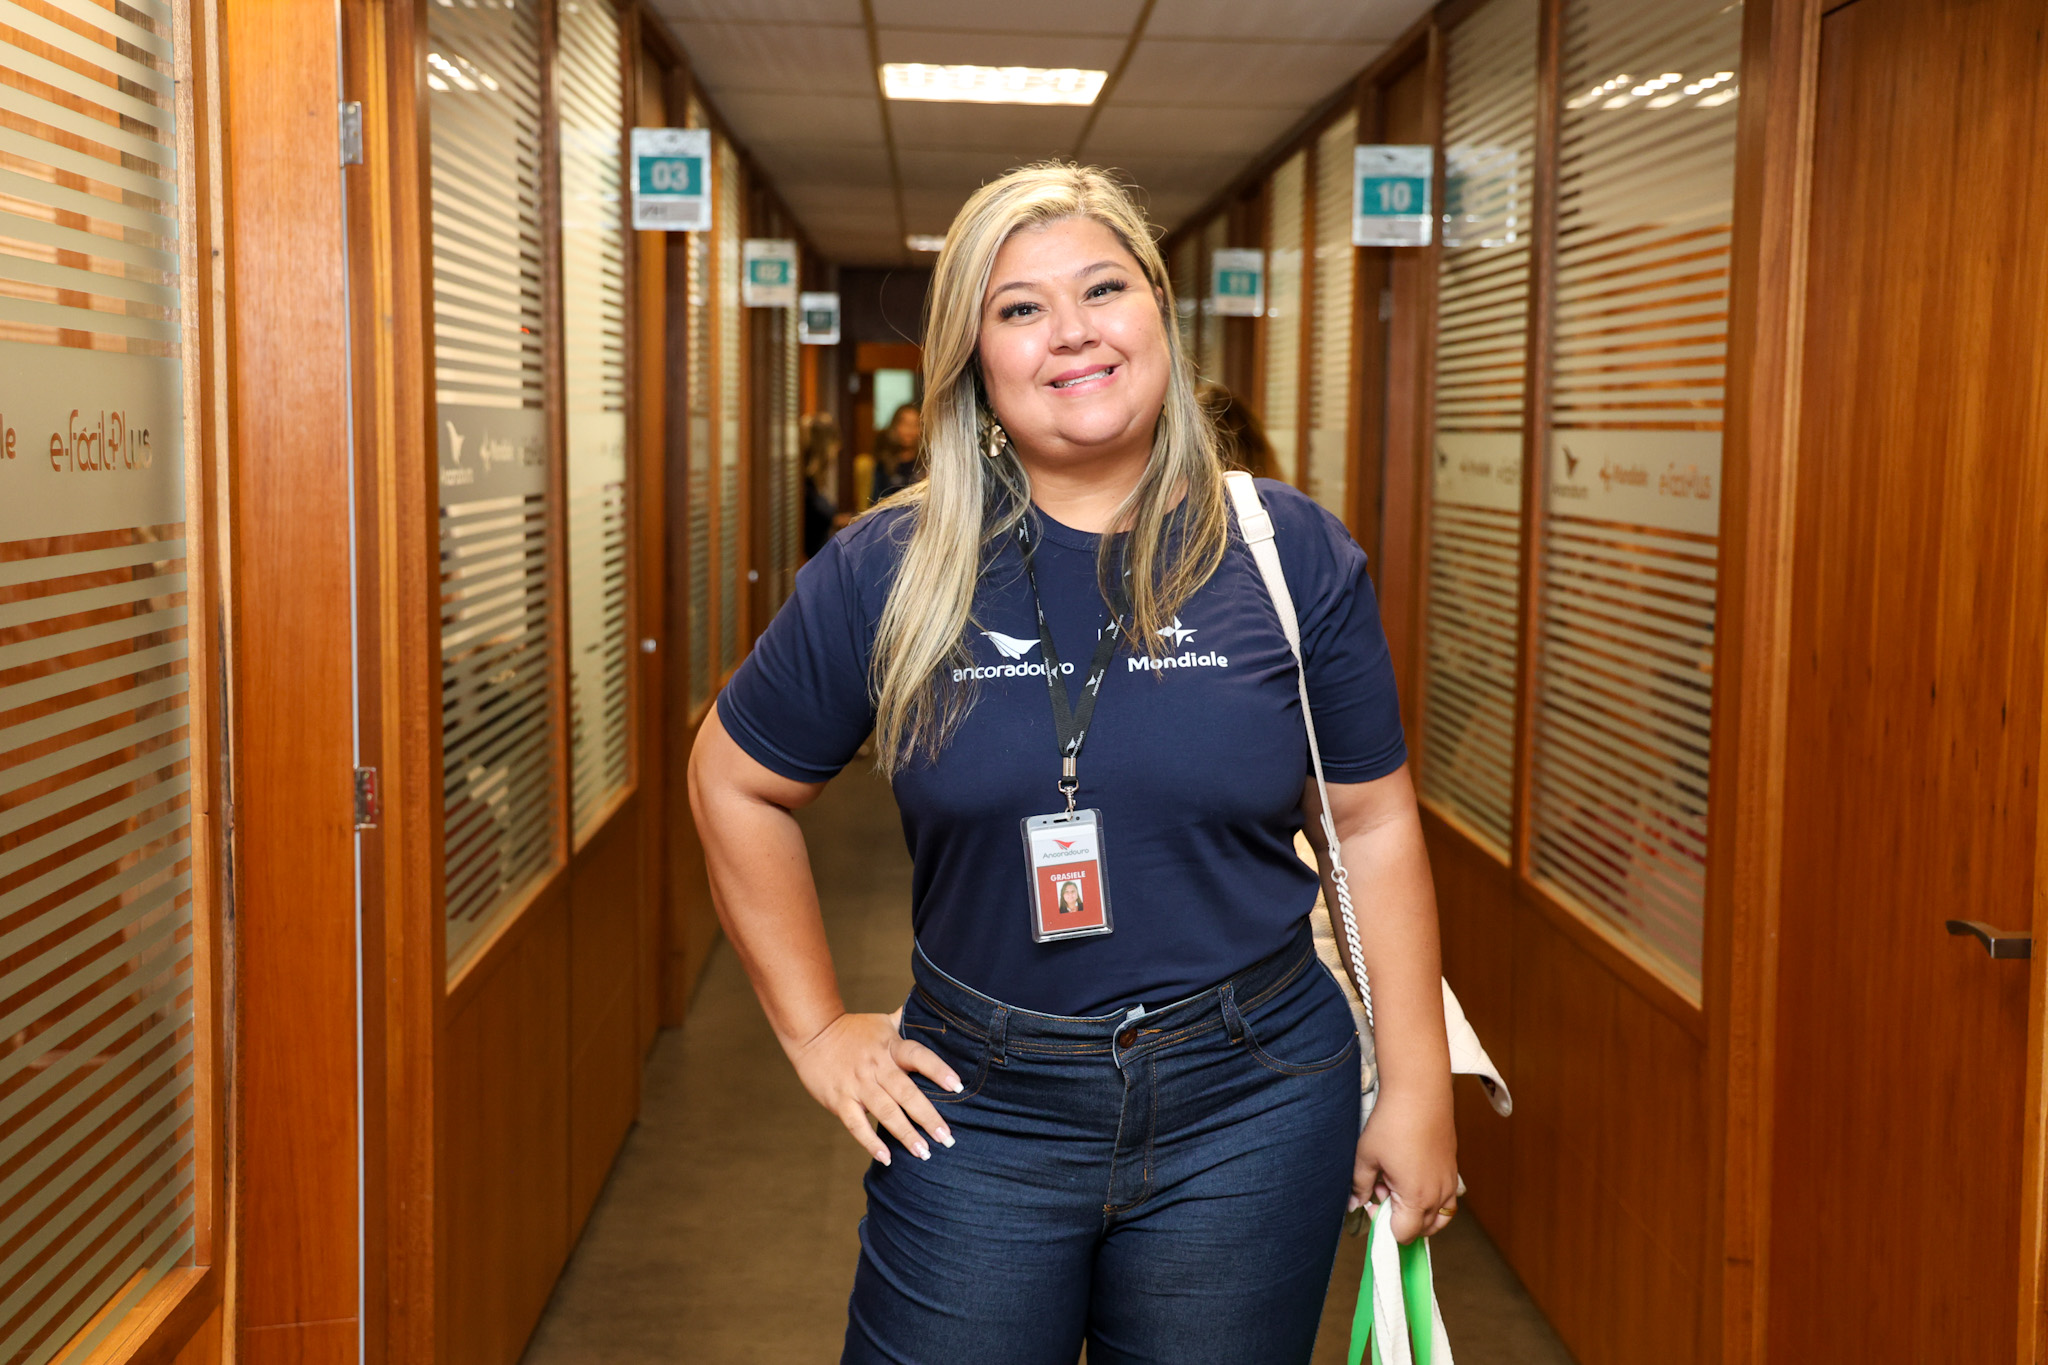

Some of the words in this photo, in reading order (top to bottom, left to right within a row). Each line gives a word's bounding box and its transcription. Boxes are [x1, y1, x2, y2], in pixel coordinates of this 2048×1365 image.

[652, 160, 690, 192] 03
[1377, 181, 1412, 212] 10
[1127, 651, 1229, 673] Mondiale
[1042, 848, 1090, 860] Ancoradouro
[1050, 870, 1087, 882] GRASIELE
